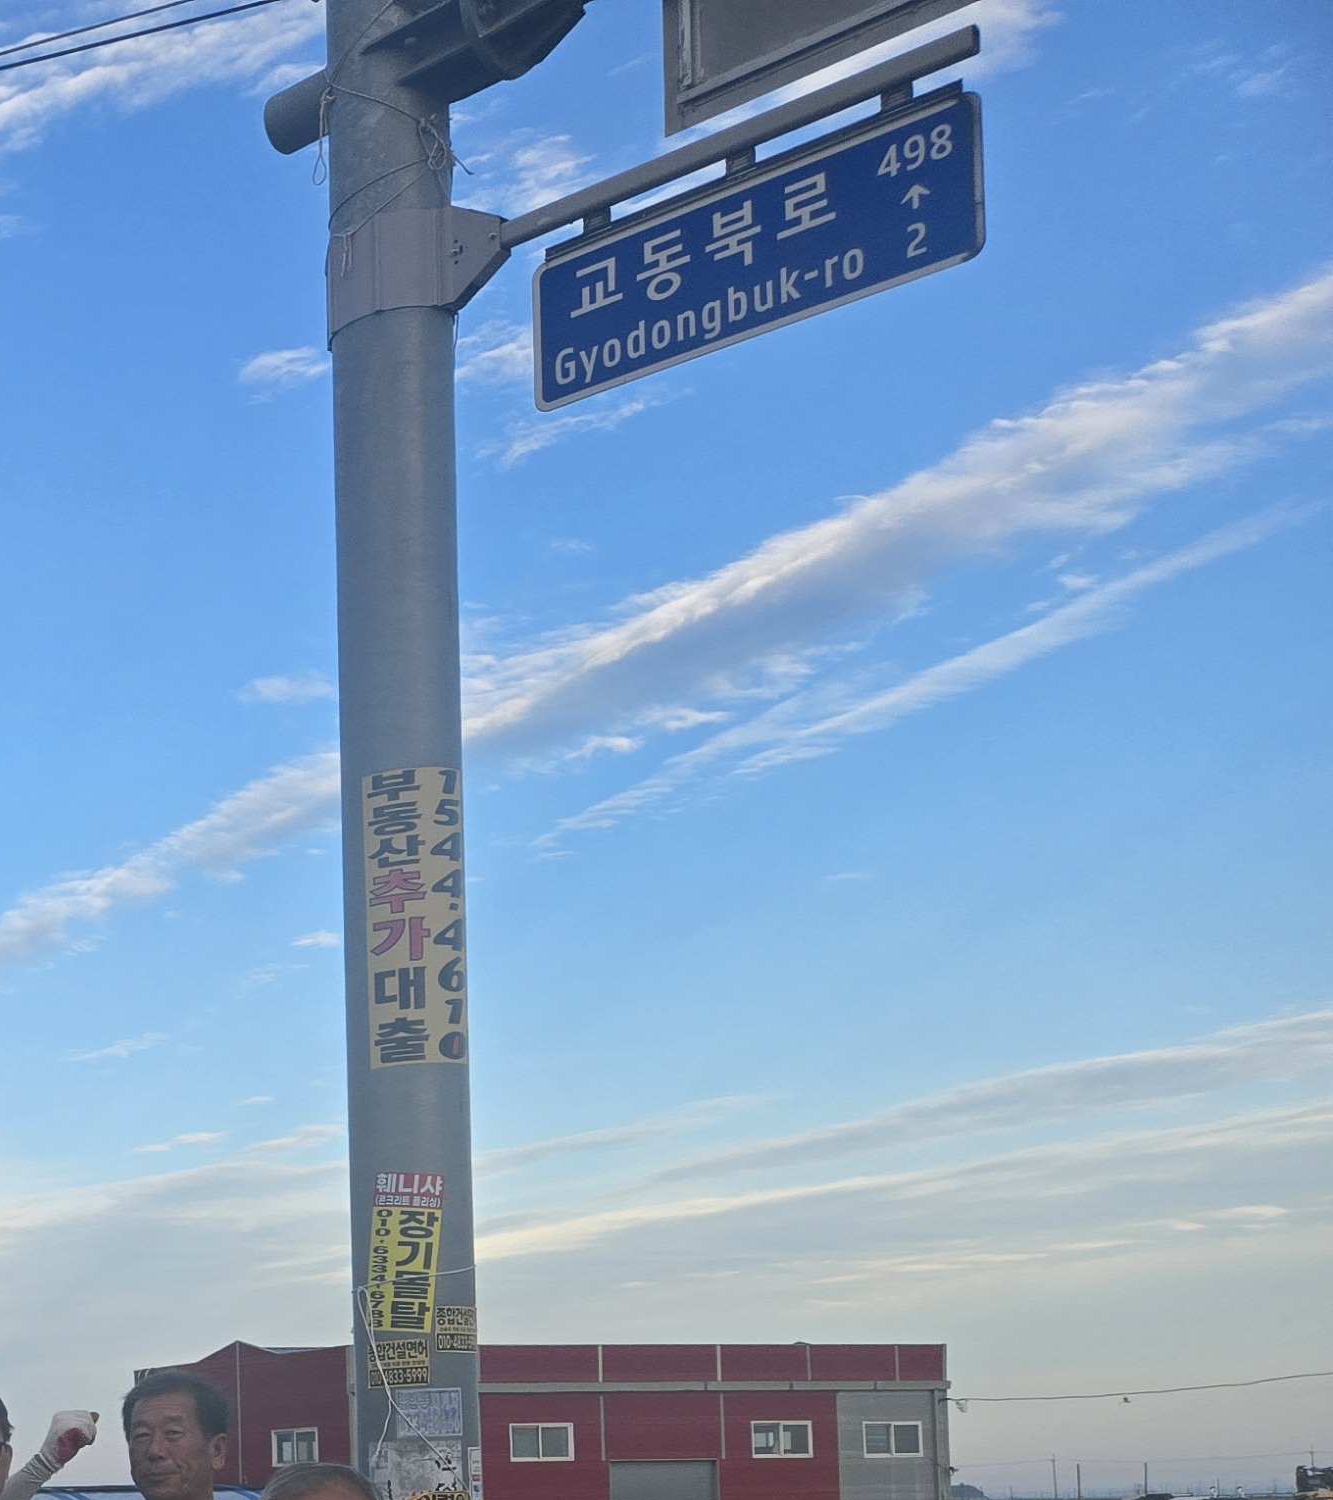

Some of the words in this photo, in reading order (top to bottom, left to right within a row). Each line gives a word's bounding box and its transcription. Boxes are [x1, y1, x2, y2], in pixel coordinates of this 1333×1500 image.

[877, 123, 954, 180] 498
[570, 172, 836, 318] 교동북로
[906, 223, 928, 258] 2
[555, 248, 864, 386] Gyodongbuk-ro
[376, 1173, 443, 1196] 훼니샤
